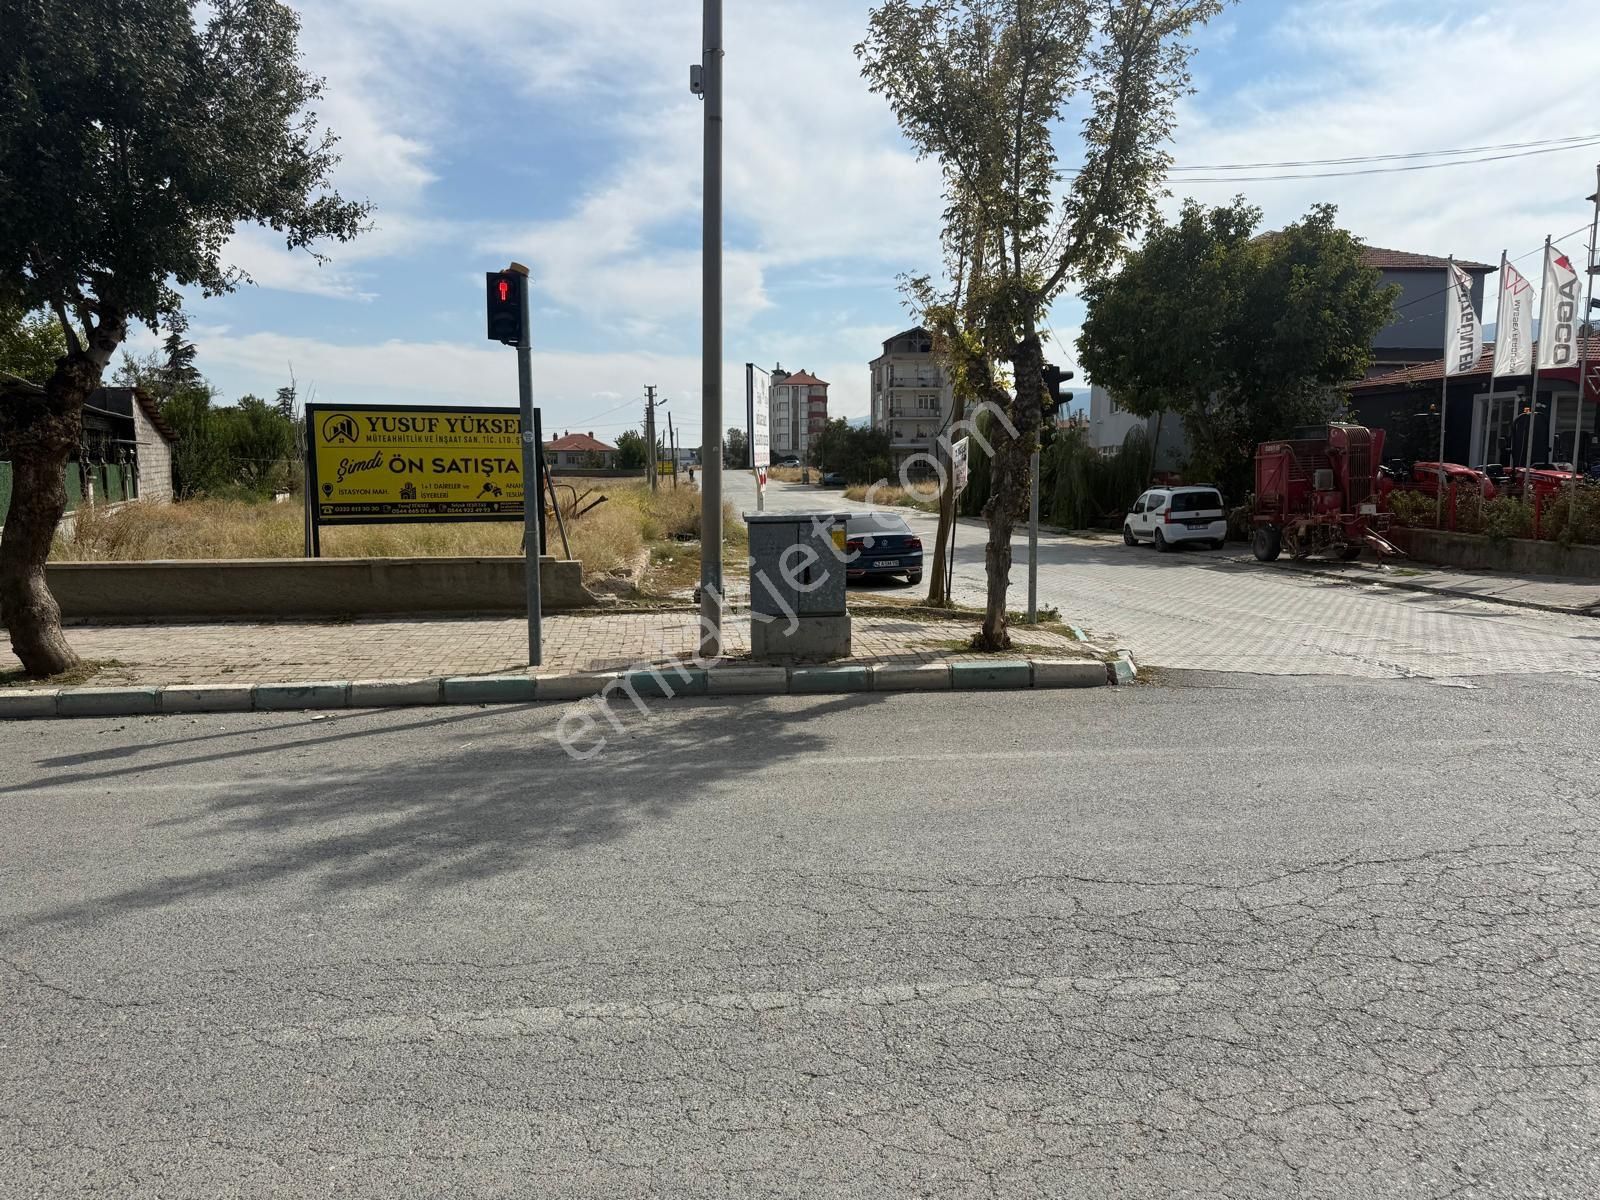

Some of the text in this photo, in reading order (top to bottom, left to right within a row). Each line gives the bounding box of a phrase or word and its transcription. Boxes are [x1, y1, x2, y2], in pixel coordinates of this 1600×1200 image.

[365, 417, 440, 433] YUSUF
[366, 434, 422, 443] MÜTEAHHİTLİK
[424, 435, 433, 443] VE
[435, 434, 462, 444] İNŞAAT
[336, 450, 384, 483] Şimdi
[388, 453, 520, 477] ÖN SATIŞTA
